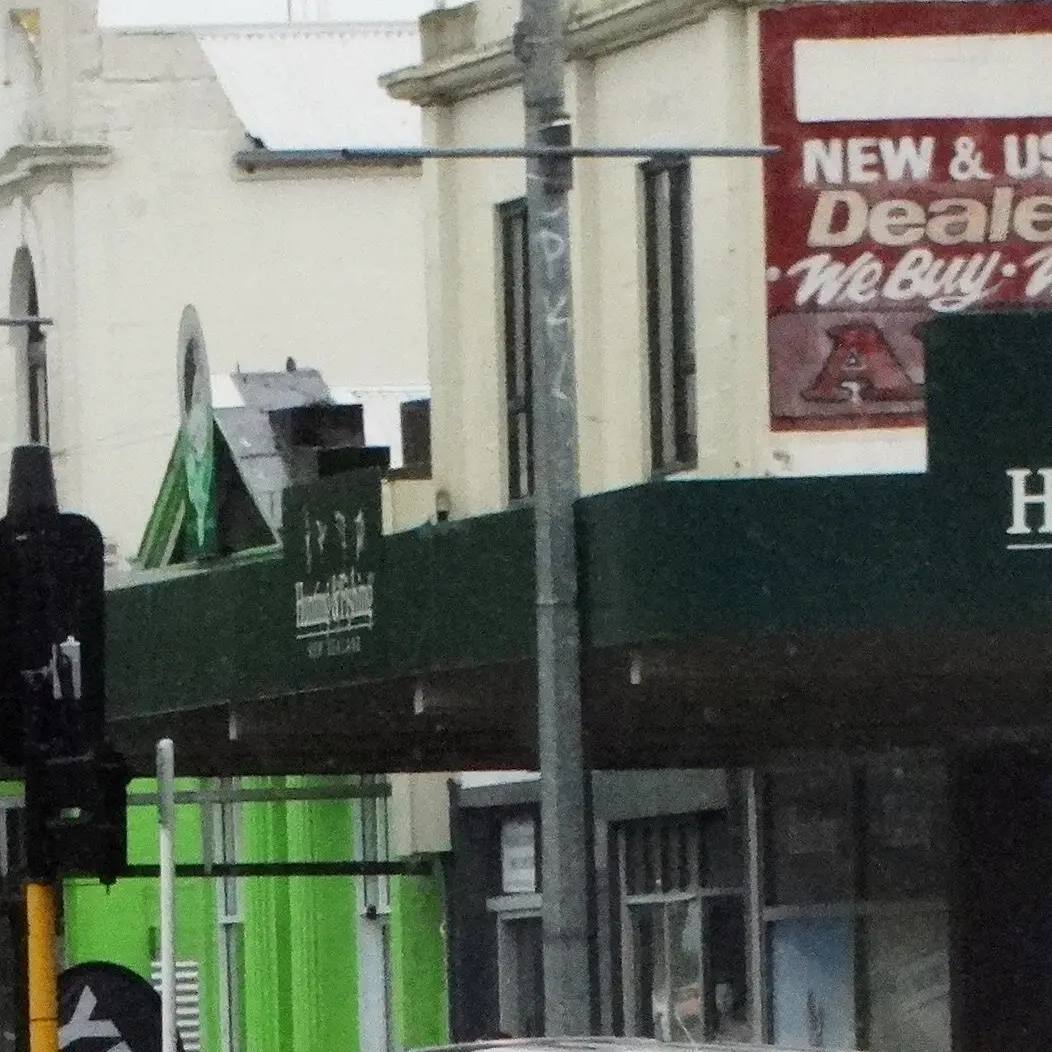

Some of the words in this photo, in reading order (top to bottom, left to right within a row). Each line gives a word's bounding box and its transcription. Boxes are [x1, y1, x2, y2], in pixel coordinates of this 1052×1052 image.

[802, 136, 936, 185] NEW
[949, 136, 995, 180] &
[807, 187, 1052, 247] Deale
[788, 252, 883, 305] We
[883, 249, 1004, 313] Buy
